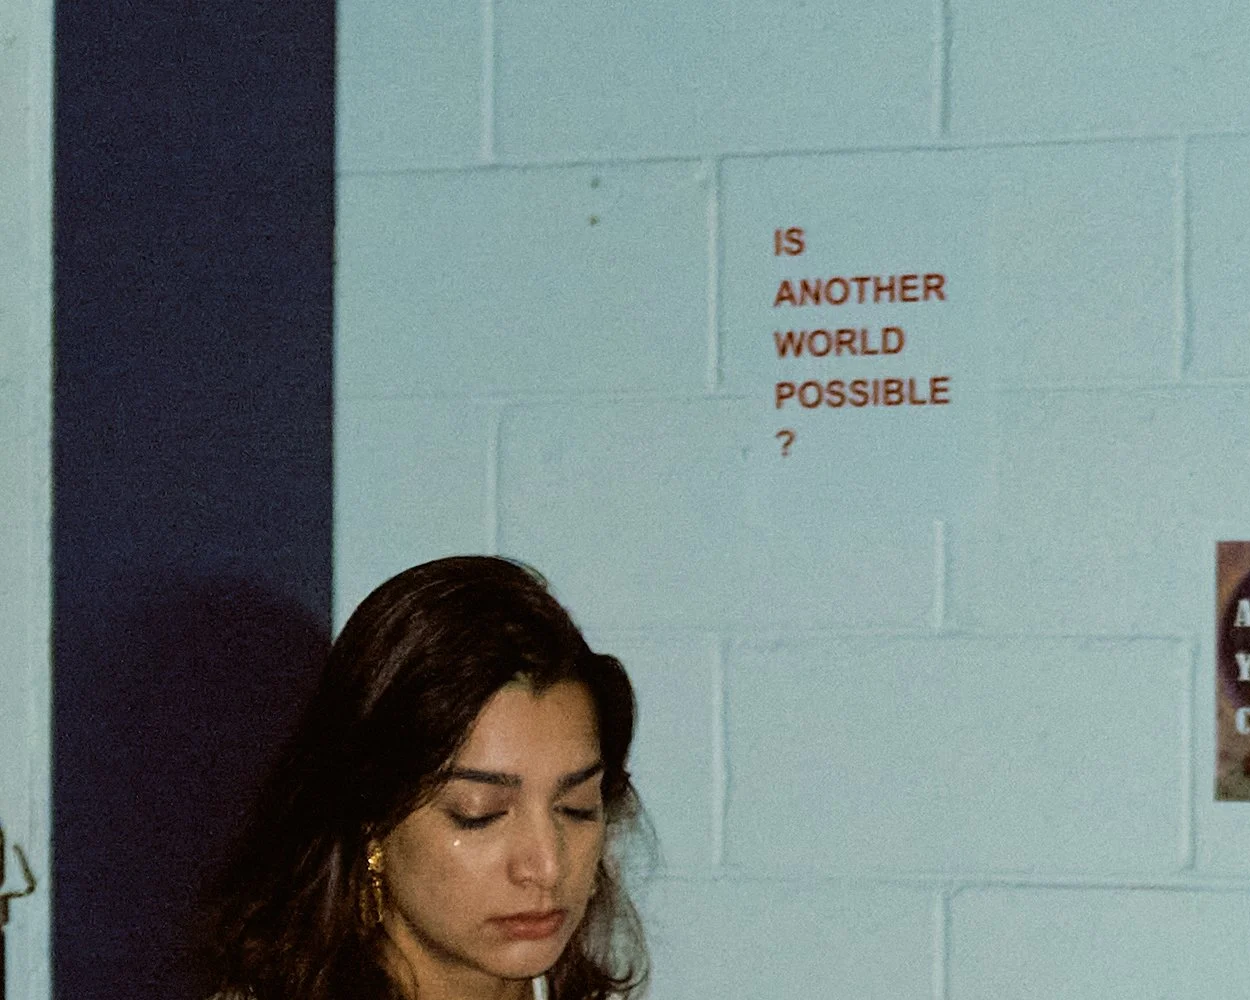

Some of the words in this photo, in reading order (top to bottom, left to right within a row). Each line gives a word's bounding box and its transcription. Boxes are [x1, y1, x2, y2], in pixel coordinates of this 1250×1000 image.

[773, 227, 805, 257] IS
[774, 273, 946, 306] ANOTHER
[773, 326, 905, 358] WORLD
[774, 376, 952, 410] POSSIBLE
[775, 430, 796, 457] ?
